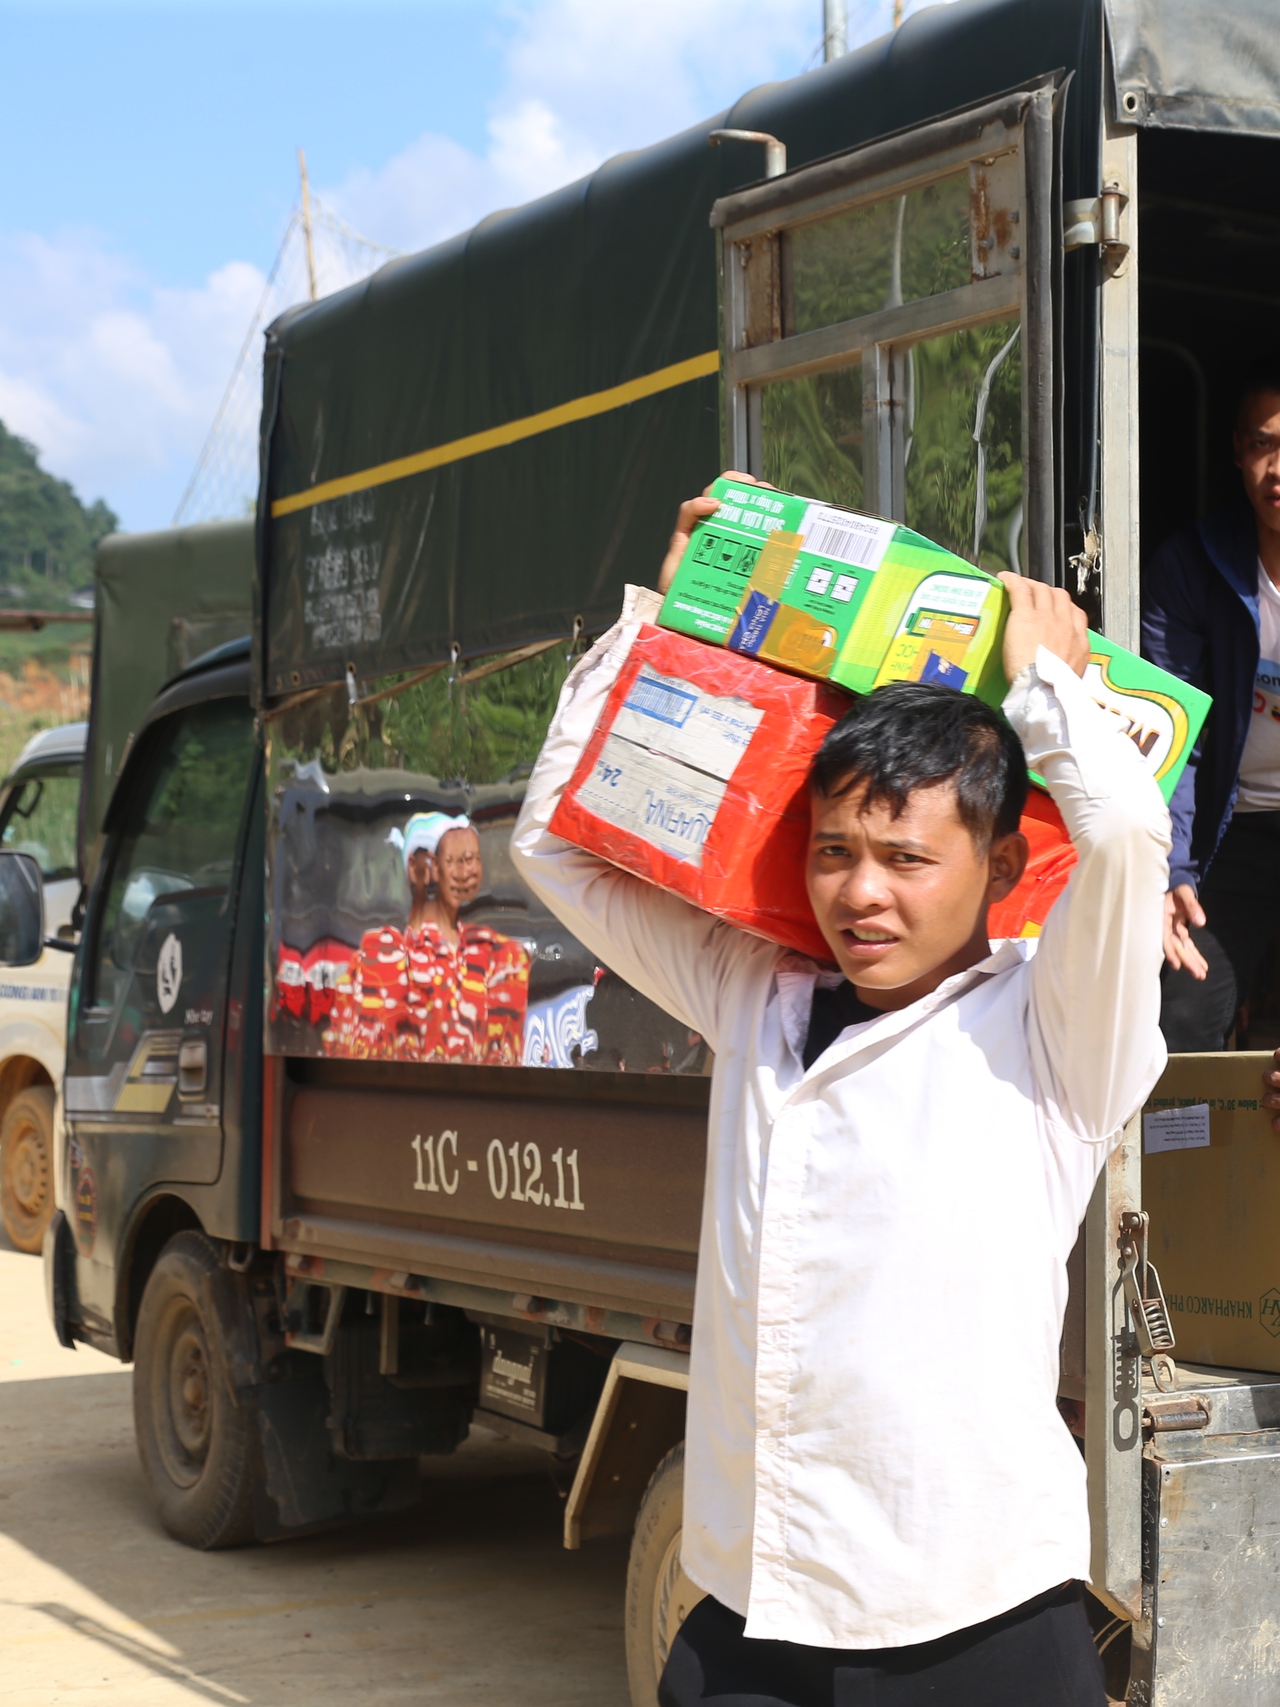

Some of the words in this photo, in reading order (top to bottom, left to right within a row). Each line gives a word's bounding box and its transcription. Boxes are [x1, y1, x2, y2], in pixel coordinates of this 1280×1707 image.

[724, 488, 750, 504] 180ml
[749, 495, 758, 504] x
[713, 502, 743, 522] MẠC
[771, 501, 785, 513] 48
[599, 763, 622, 787] 24
[645, 790, 712, 844] QUAFINA
[1210, 1099, 1215, 1109] in
[1237, 1099, 1257, 1110] Below
[408, 1127, 462, 1195] 11C
[483, 1138, 589, 1210] 012.11
[1186, 1295, 1252, 1318] KHAPHARCO
